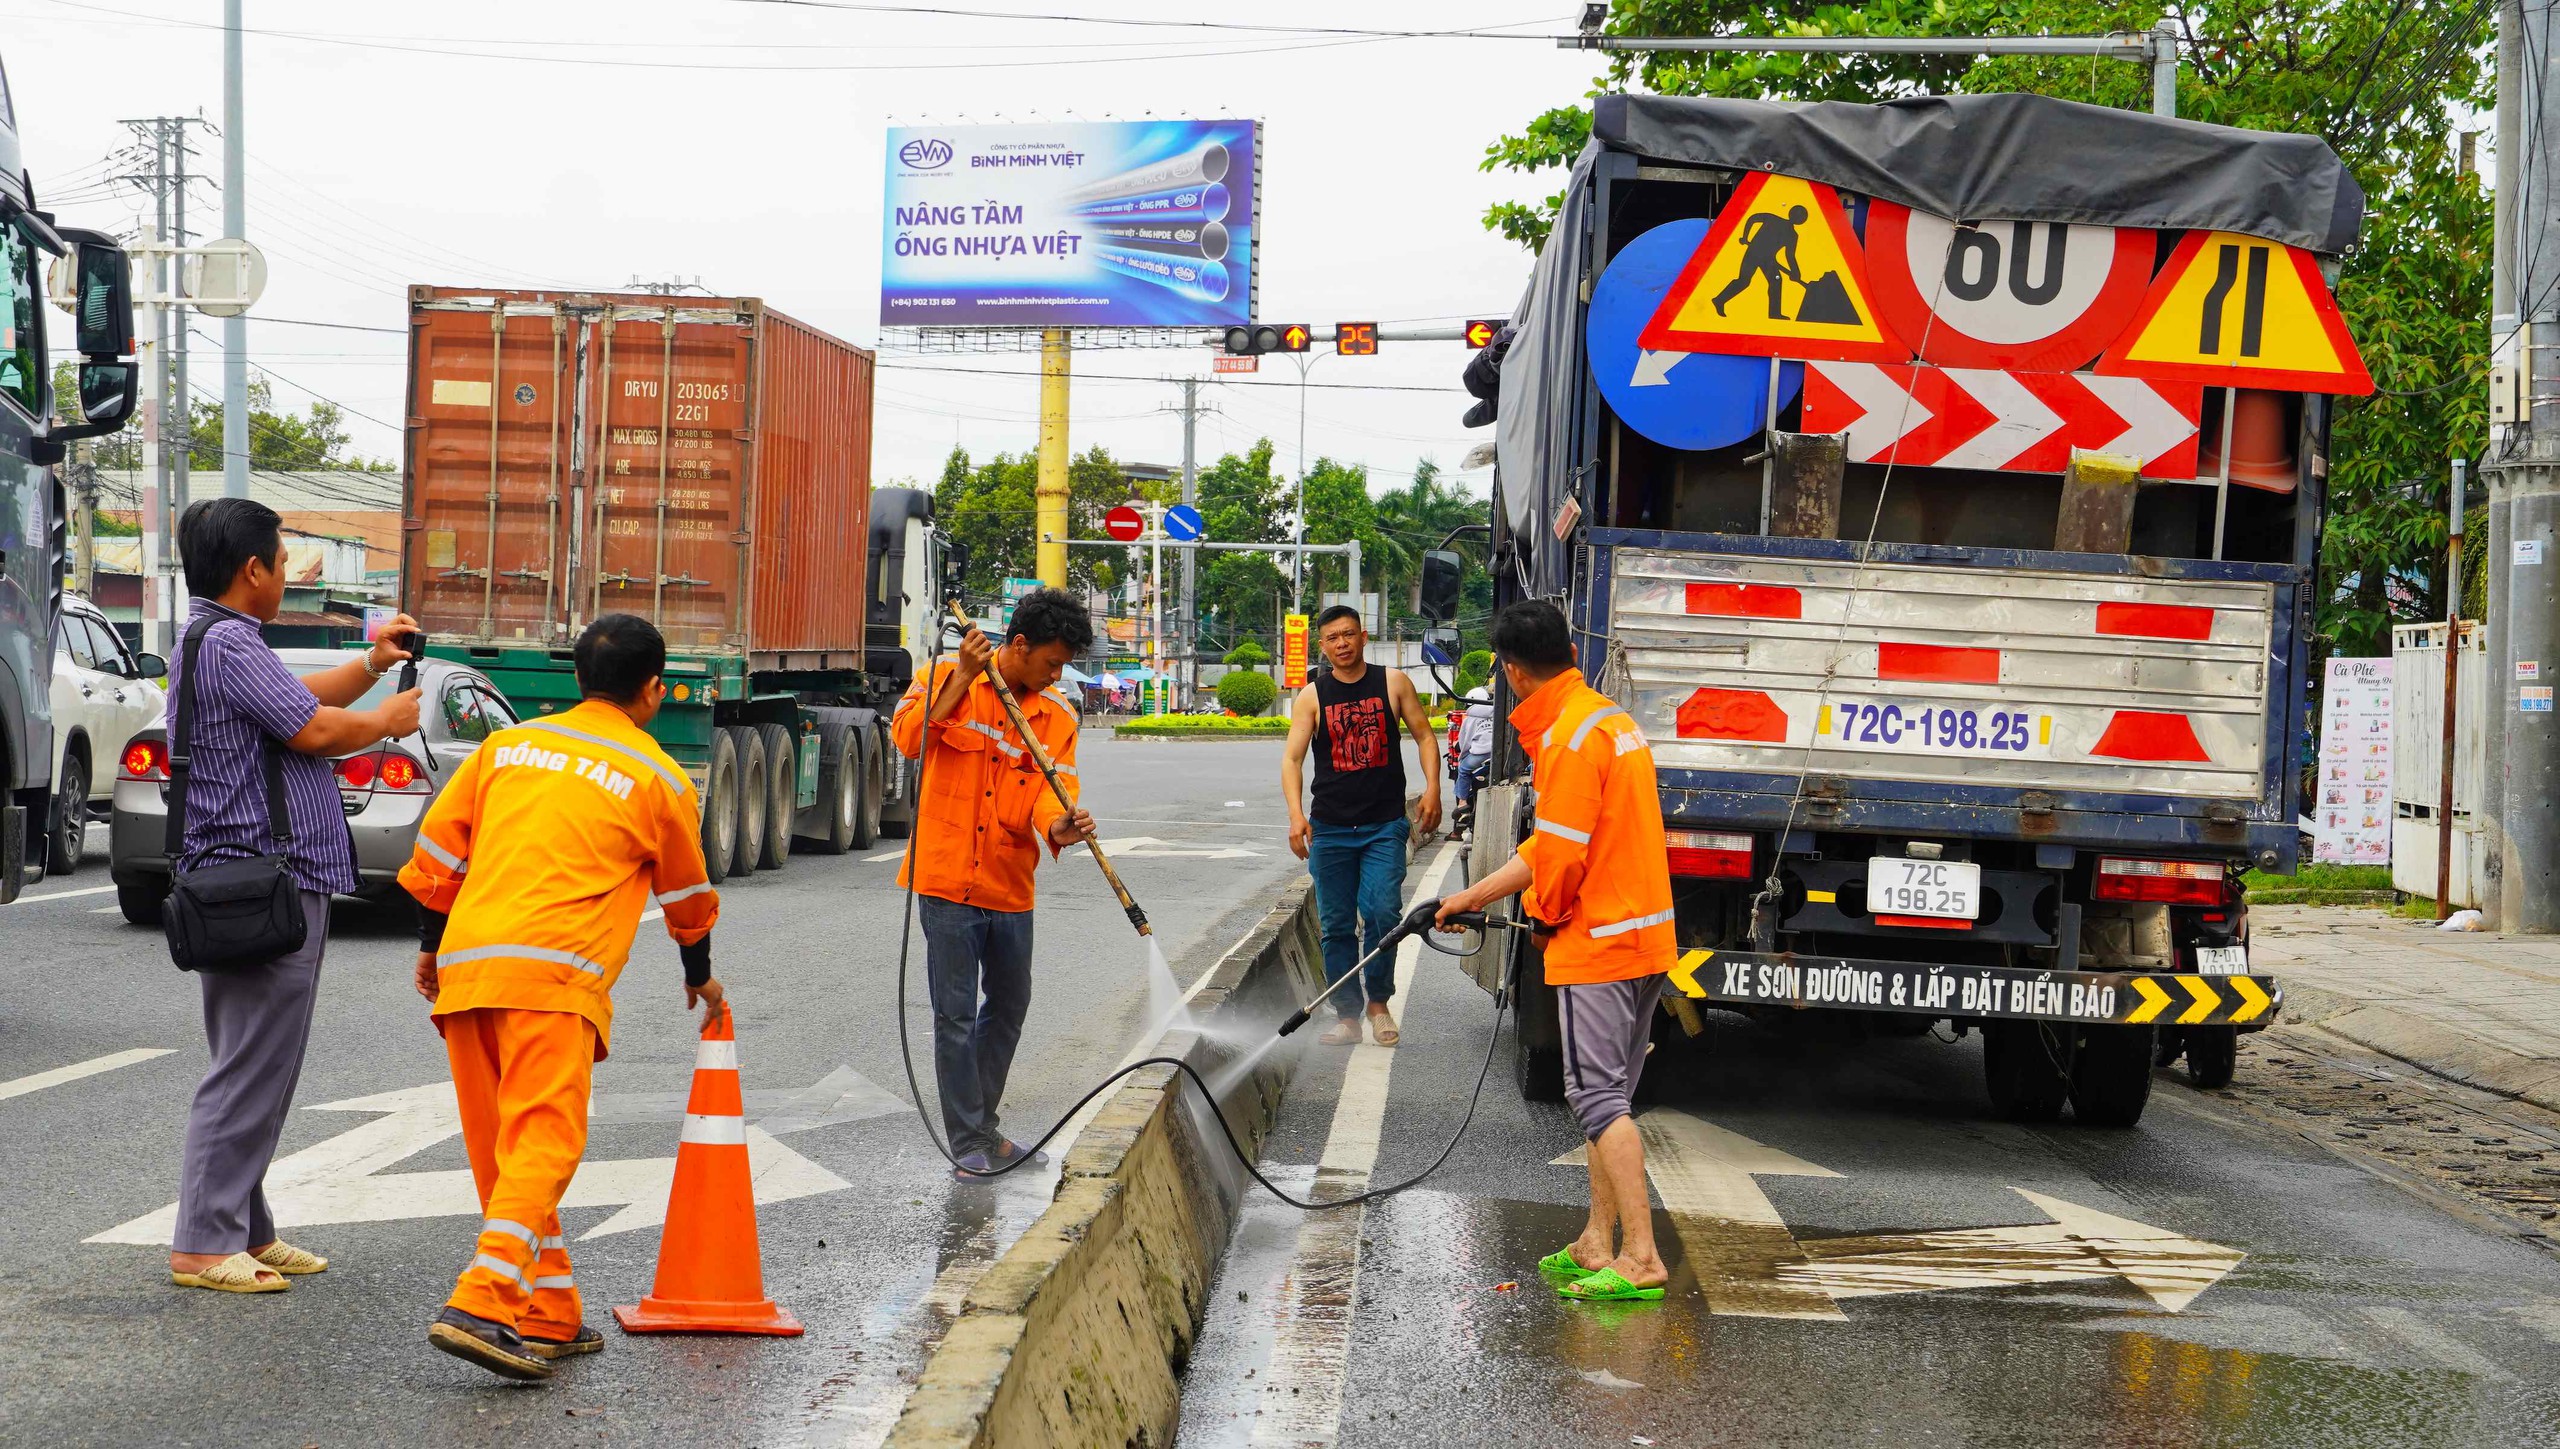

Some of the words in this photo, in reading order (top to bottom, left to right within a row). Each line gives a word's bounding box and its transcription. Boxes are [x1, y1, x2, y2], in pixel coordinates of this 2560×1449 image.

[1050, 151, 1085, 169] VIỆT
[895, 201, 965, 226] NÂNG
[971, 199, 1023, 225] TẦM
[1154, 199, 1170, 209] PPR
[894, 231, 947, 257] ỐNG
[954, 235, 1027, 261] NHỰA
[1033, 230, 1082, 260] VIỆT
[891, 298, 912, 308] (+84)
[913, 298, 928, 306] 902
[928, 298, 940, 306] 131
[941, 298, 956, 306] 650
[976, 297, 1110, 306] www.binhminhvietplastic.com.vn
[1339, 326, 1375, 354] 25
[625, 380, 658, 398] DRYU
[677, 383, 729, 400] 203065
[676, 404, 709, 422] 22G1
[702, 430, 713, 439] KGS
[702, 440, 713, 449] LBS
[610, 489, 626, 504] NET
[698, 490, 711, 499] KGS
[679, 520, 694, 530] 33.2
[1840, 703, 2029, 752] 72C-198.25
[575, 757, 636, 801] TÂM
[1902, 863, 1947, 887] 72C
[1884, 887, 1966, 913] 198.25
[1721, 962, 1751, 996] XE
[1757, 963, 1800, 999] SƠN
[1806, 961, 1883, 1005] ĐƯỜNG
[1890, 973, 1907, 1006] &
[1913, 966, 1956, 1009] LẮP
[1961, 971, 2006, 1016] ĐẶT
[2010, 971, 2064, 1016] BIỂN
[2069, 978, 2116, 1019] BÁO
